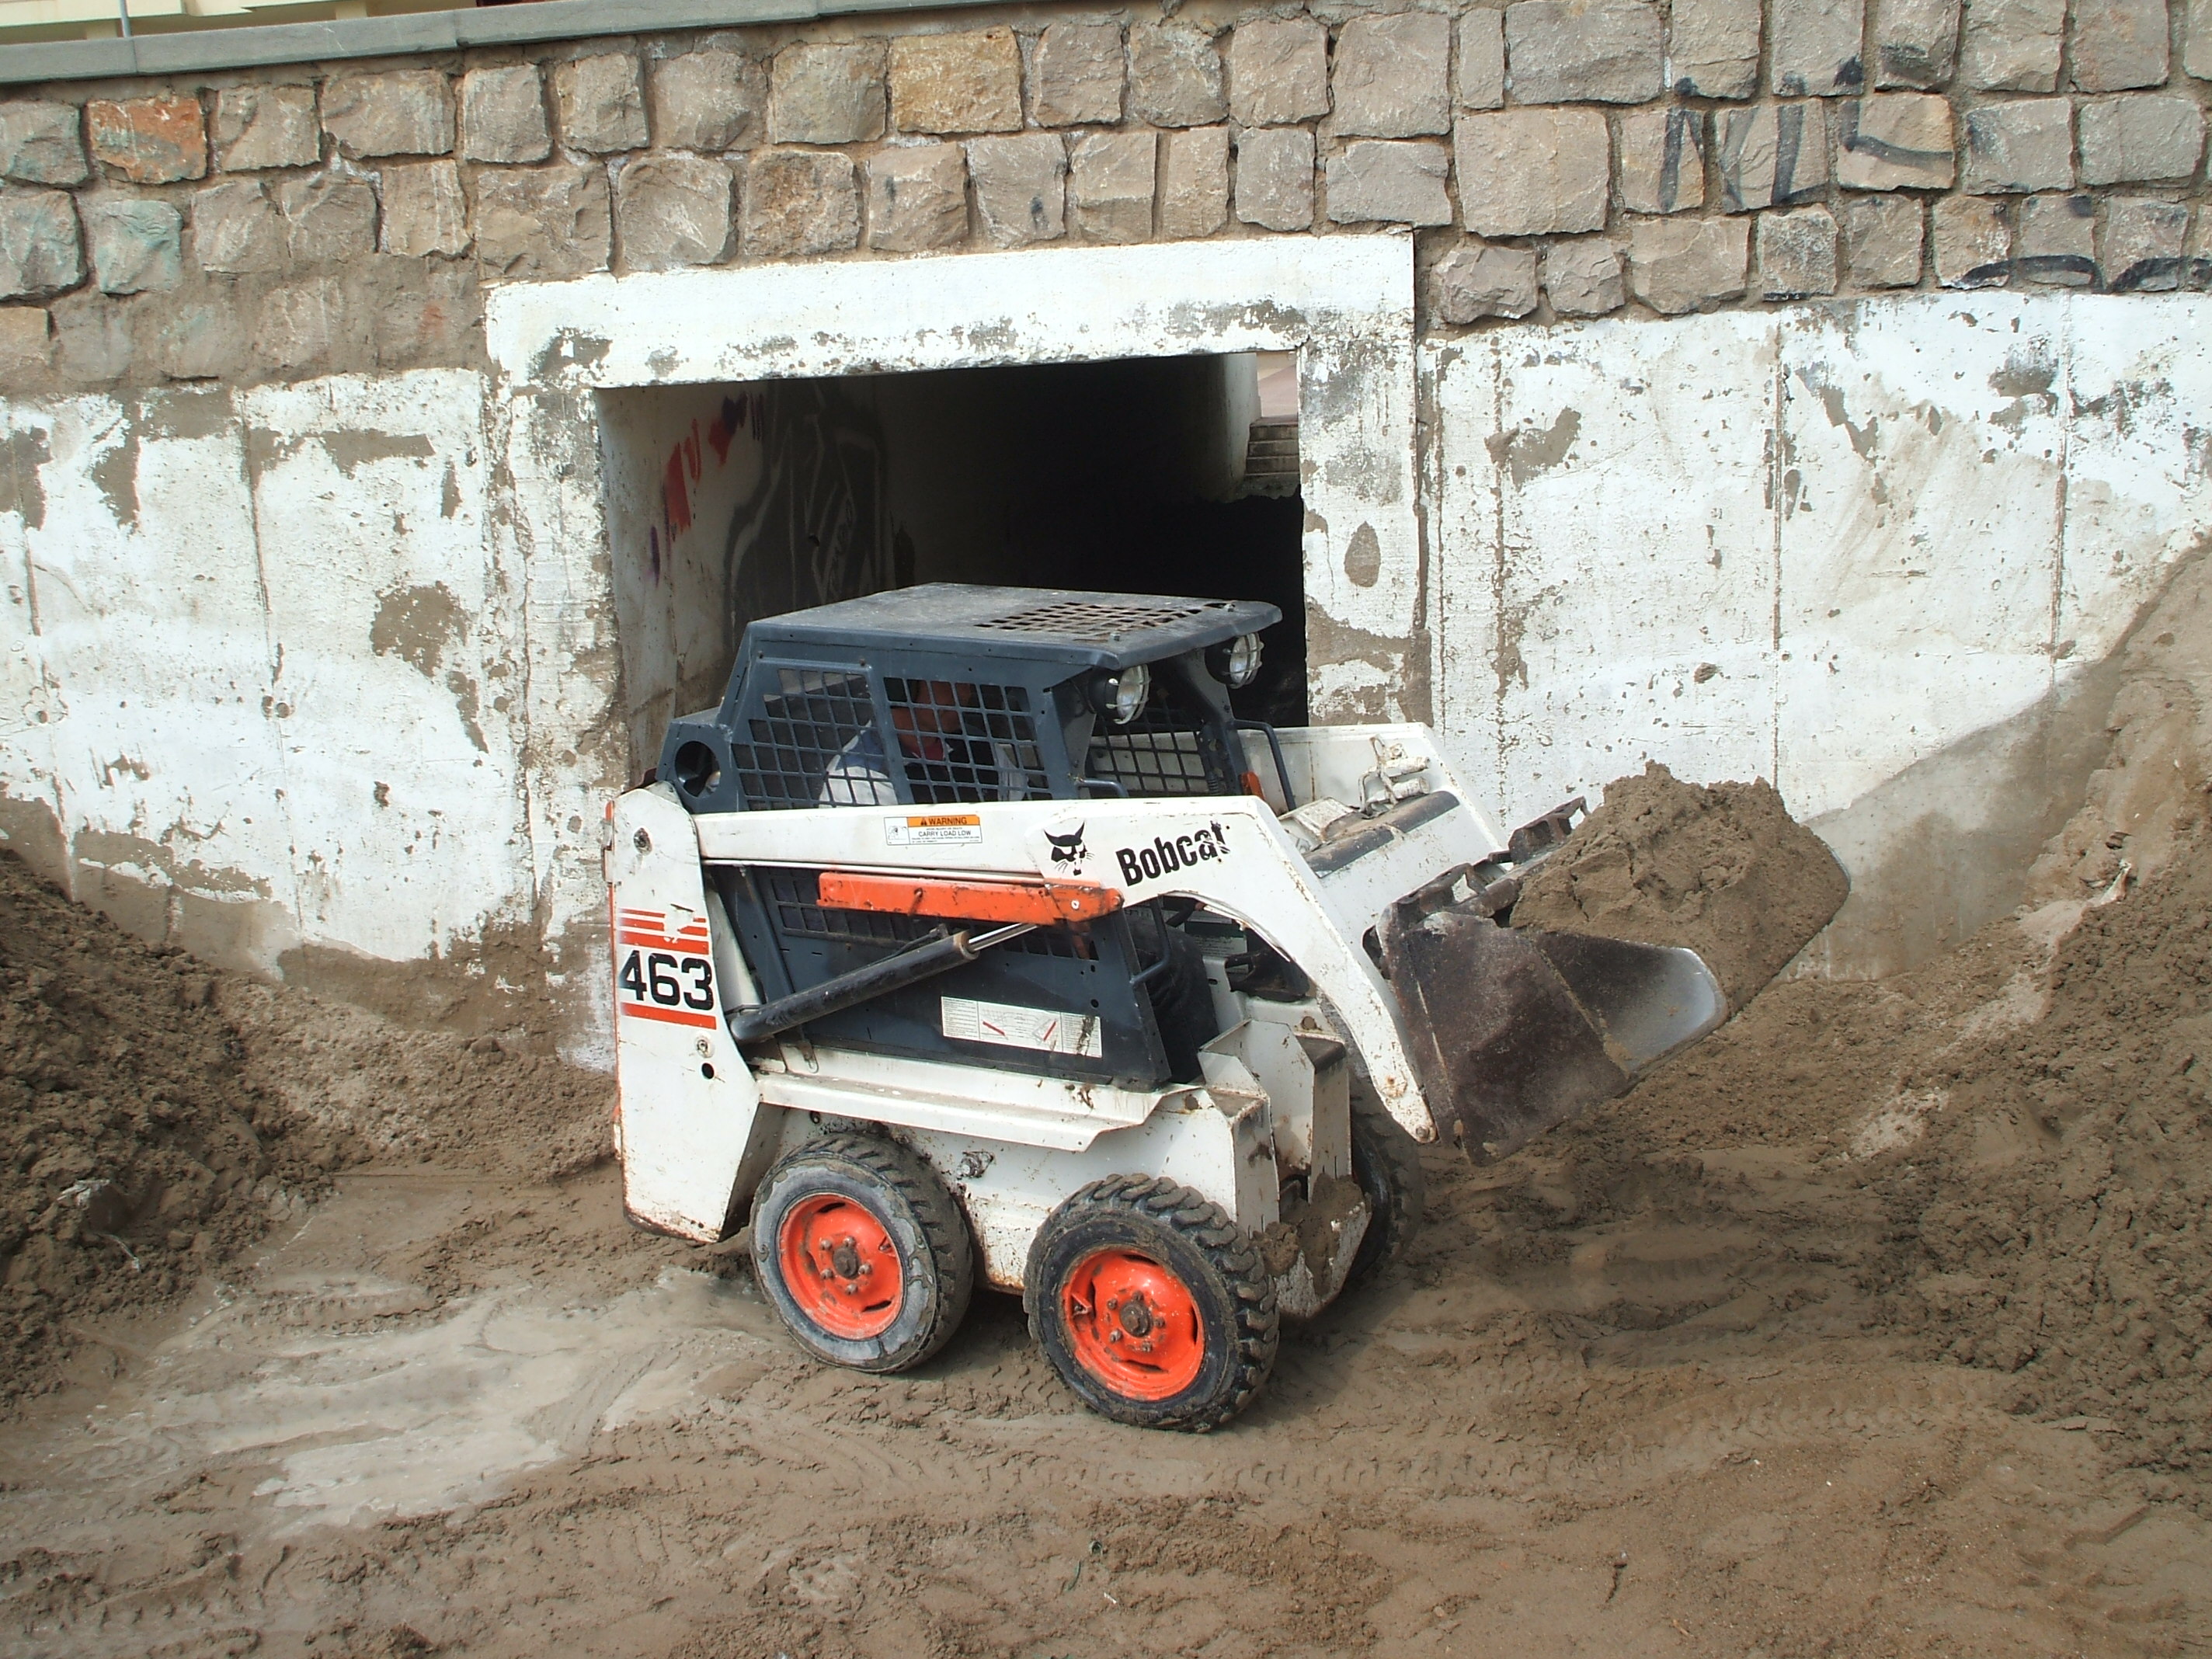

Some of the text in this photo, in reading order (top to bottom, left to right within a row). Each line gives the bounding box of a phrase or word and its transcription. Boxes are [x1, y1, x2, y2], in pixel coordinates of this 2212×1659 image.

[928, 816, 968, 826] WARNING
[1115, 820, 1231, 886] Bobcat
[618, 949, 714, 1010] 463
